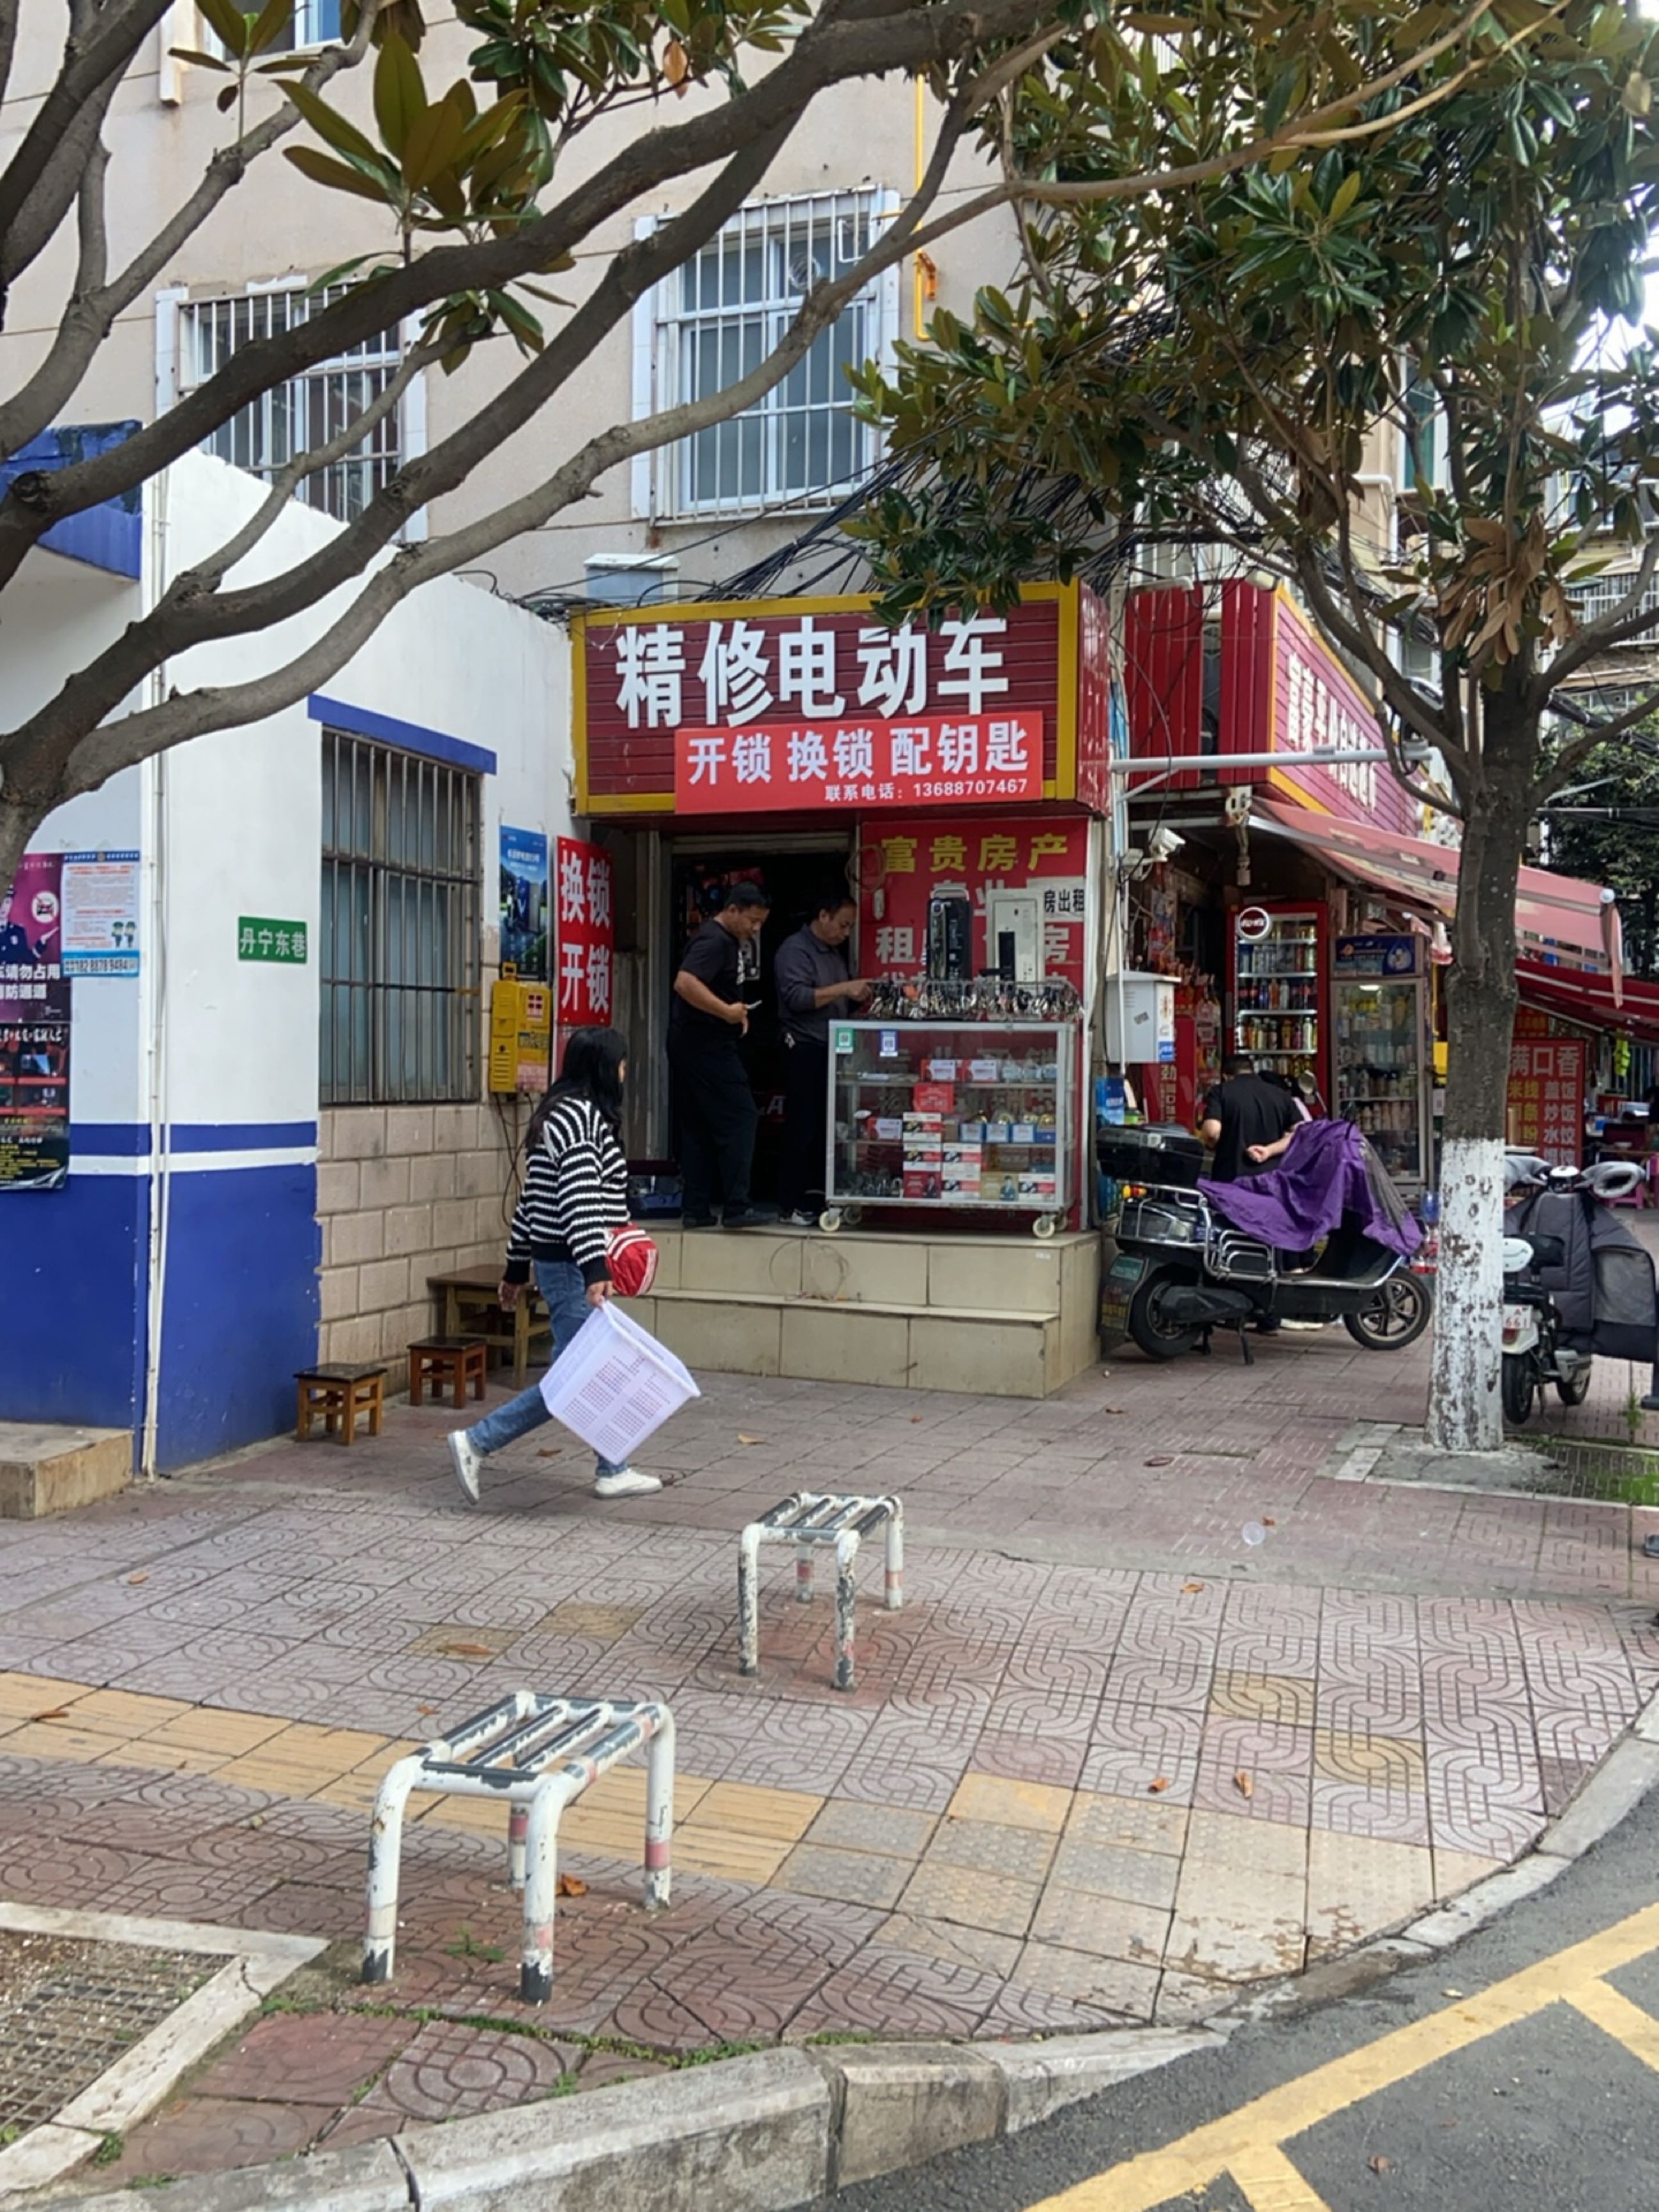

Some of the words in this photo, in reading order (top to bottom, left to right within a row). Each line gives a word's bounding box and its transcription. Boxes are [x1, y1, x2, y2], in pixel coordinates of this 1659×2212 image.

[616, 616, 1009, 729] 精修电动车
[687, 733, 772, 785] 开锁
[787, 728, 874, 782] 换锁
[890, 721, 1029, 777] 配钥匙
[913, 778, 1028, 797] 13688707467
[881, 833, 1068, 872] 富贵房产
[561, 849, 610, 928] 换锁
[240, 927, 305, 958] 丹宁东巷
[561, 943, 610, 1014] 开锁
